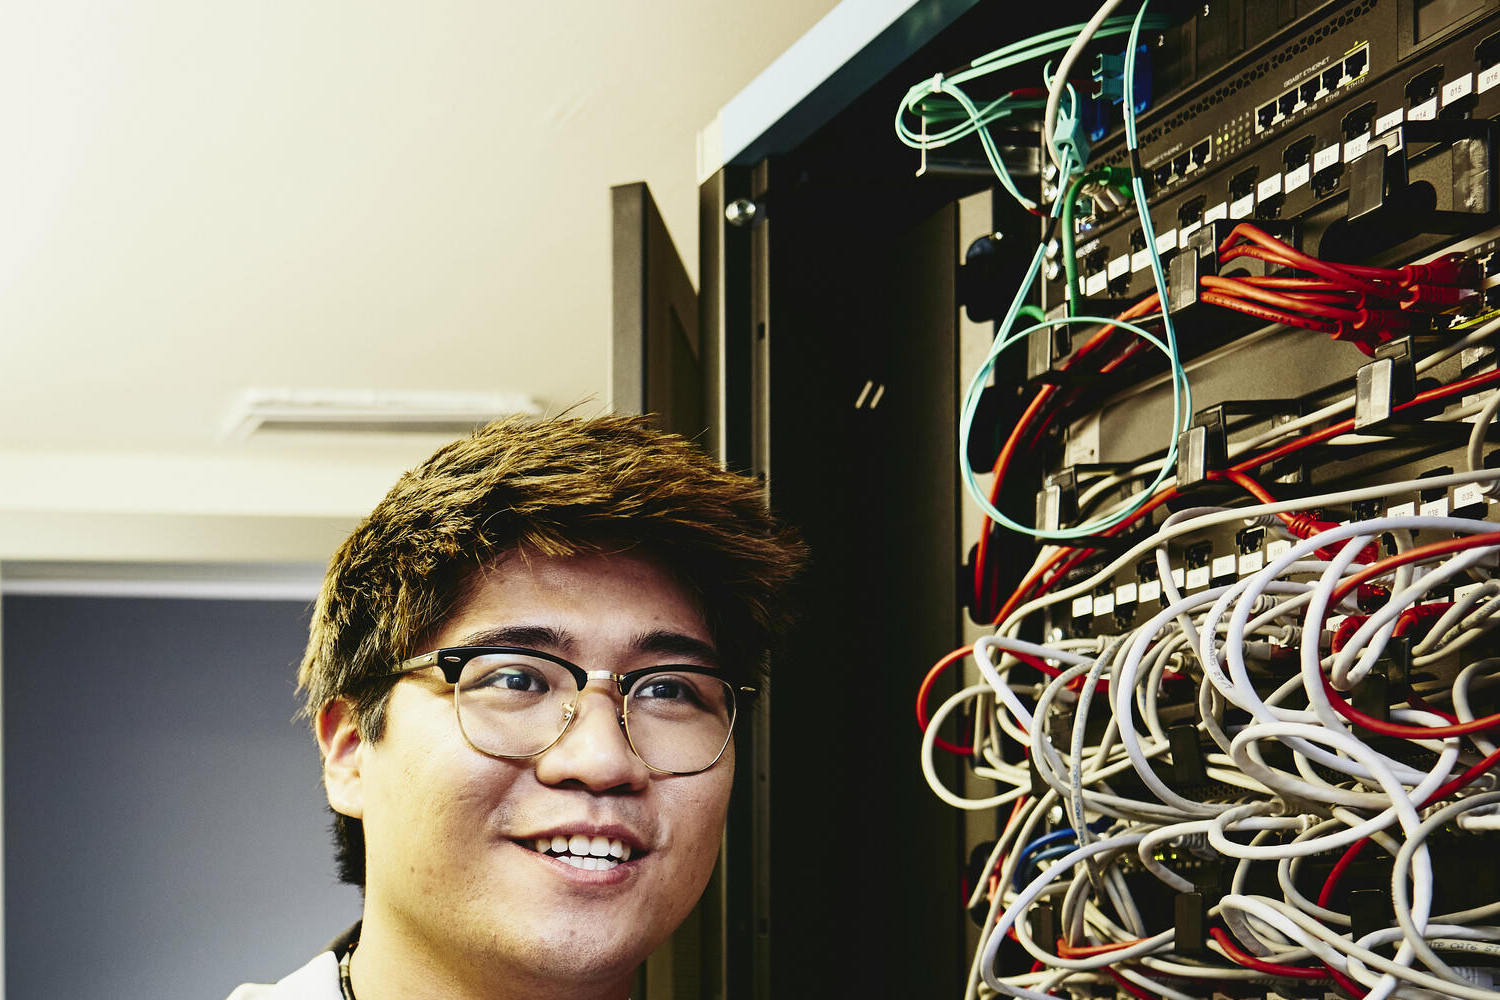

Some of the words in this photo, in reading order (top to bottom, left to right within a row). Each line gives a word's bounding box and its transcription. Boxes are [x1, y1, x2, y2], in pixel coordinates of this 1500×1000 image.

[1485, 72, 1498, 85] 016
[1450, 85, 1462, 97] 015
[1461, 490, 1474, 502] 039
